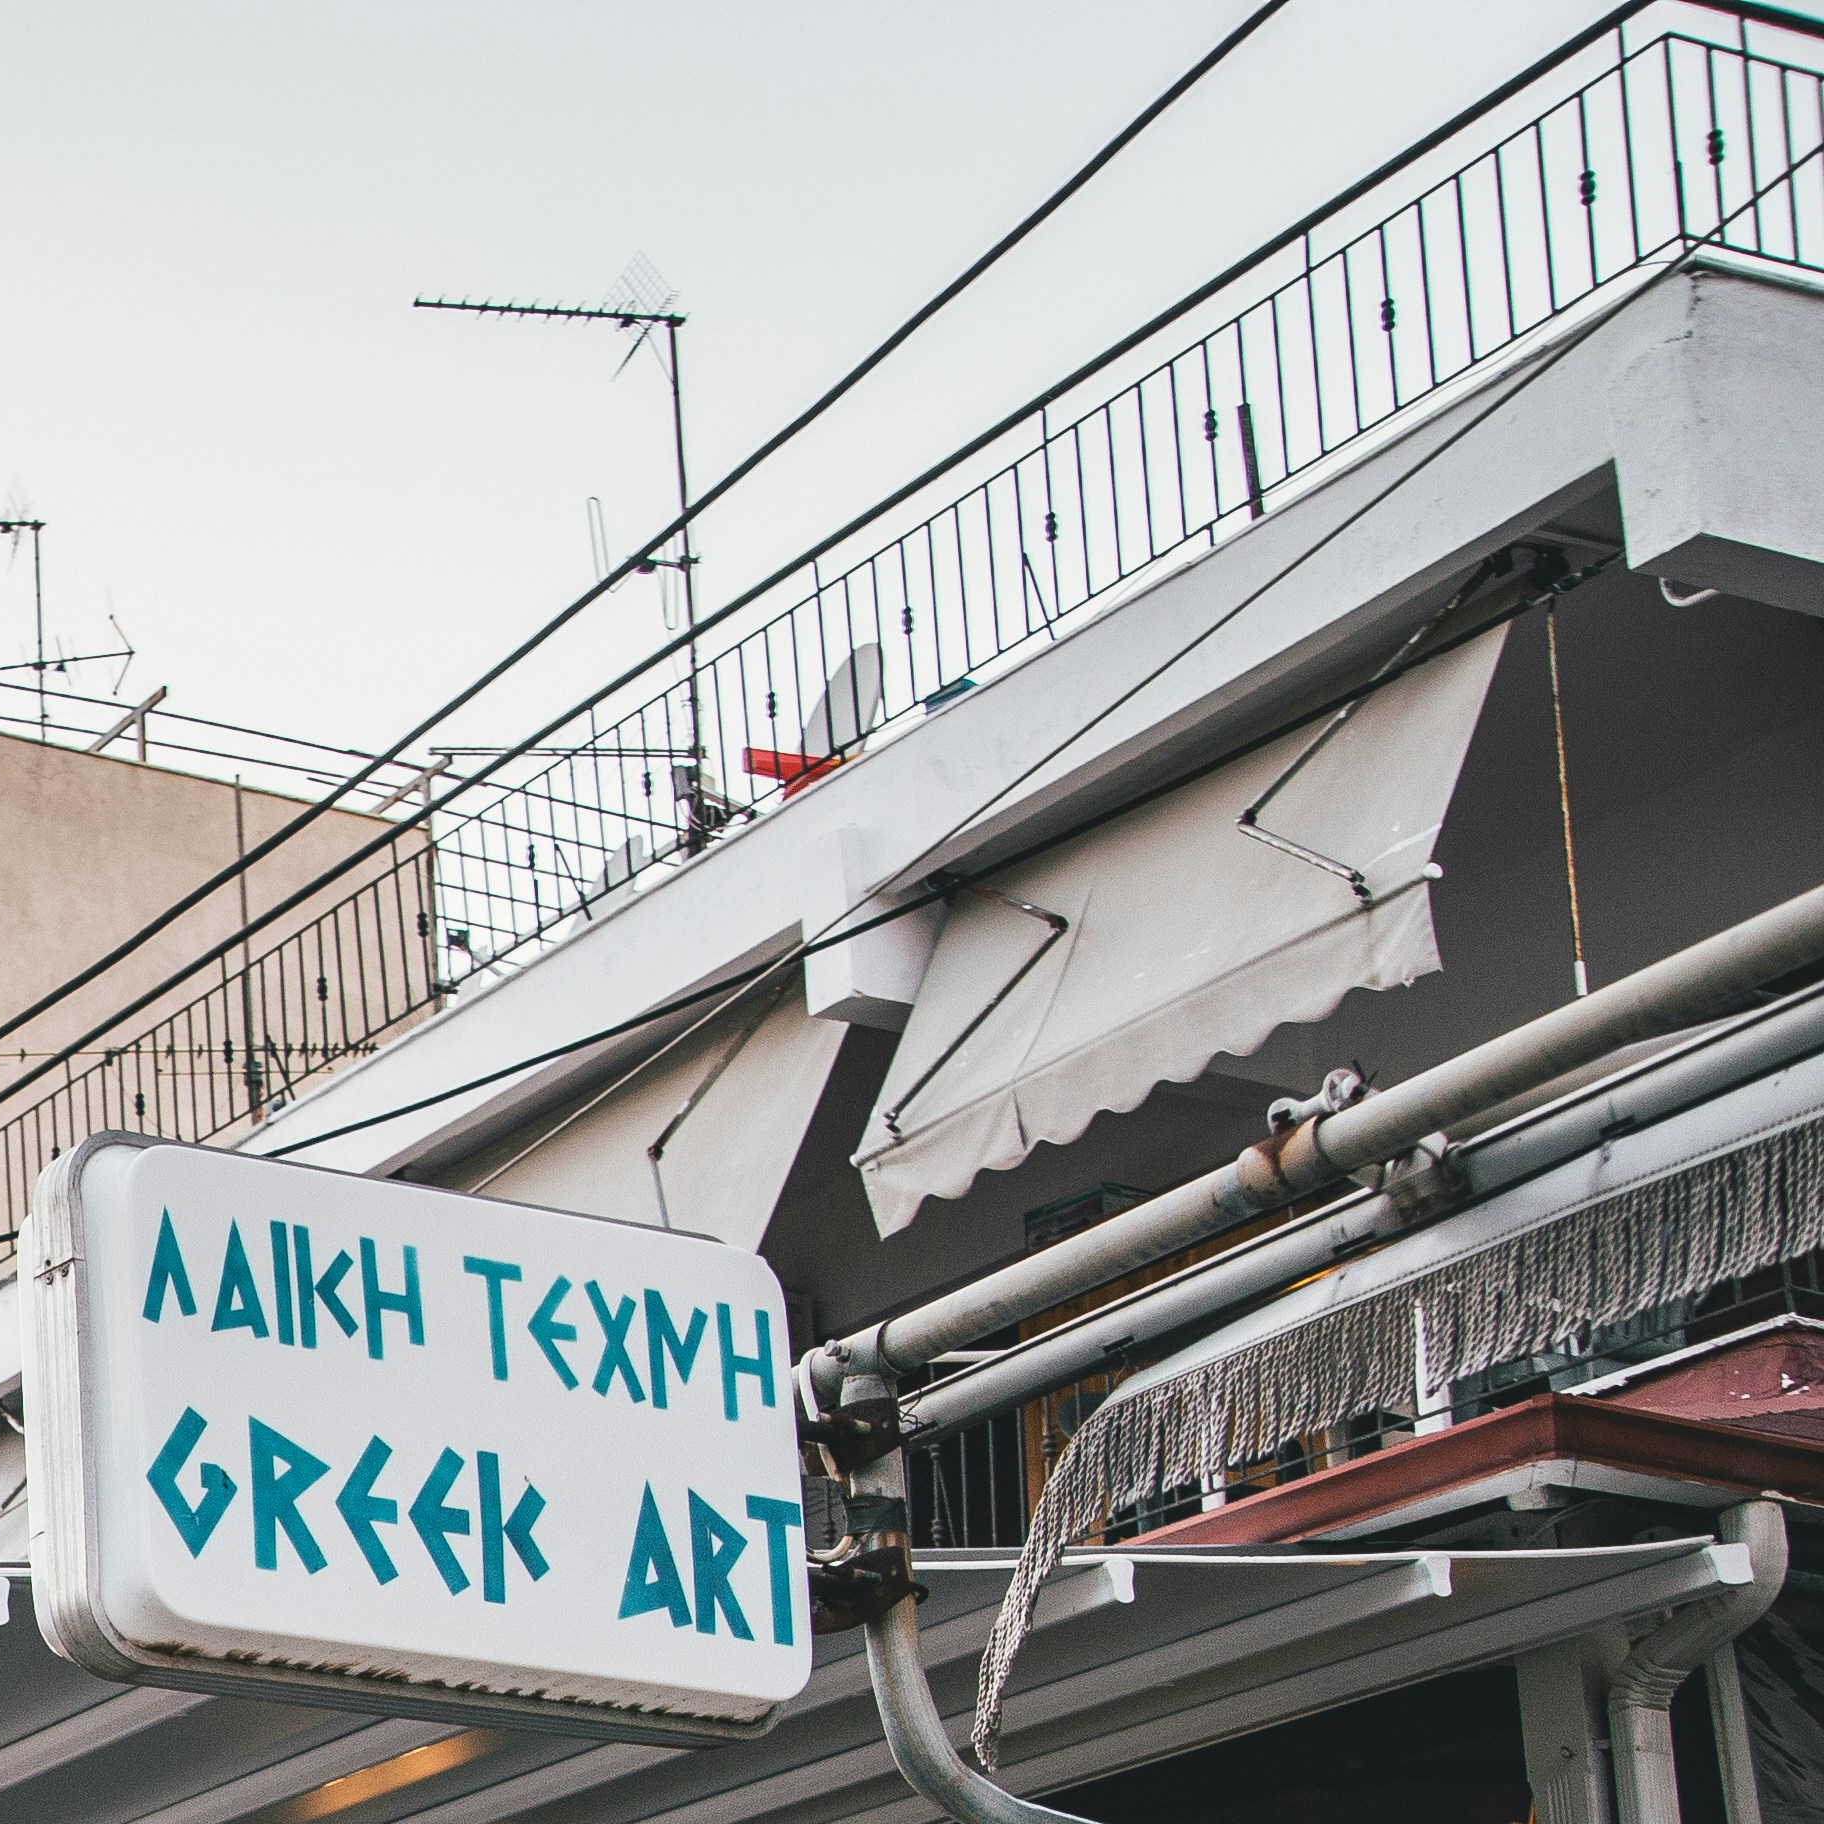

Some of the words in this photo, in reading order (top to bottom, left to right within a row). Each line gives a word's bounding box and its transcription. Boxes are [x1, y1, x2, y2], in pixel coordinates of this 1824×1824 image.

[464, 1253, 777, 1422] ΤΕΧΝΗ
[146, 1406, 550, 1605] GREEK
[617, 1480, 802, 1646] ART
